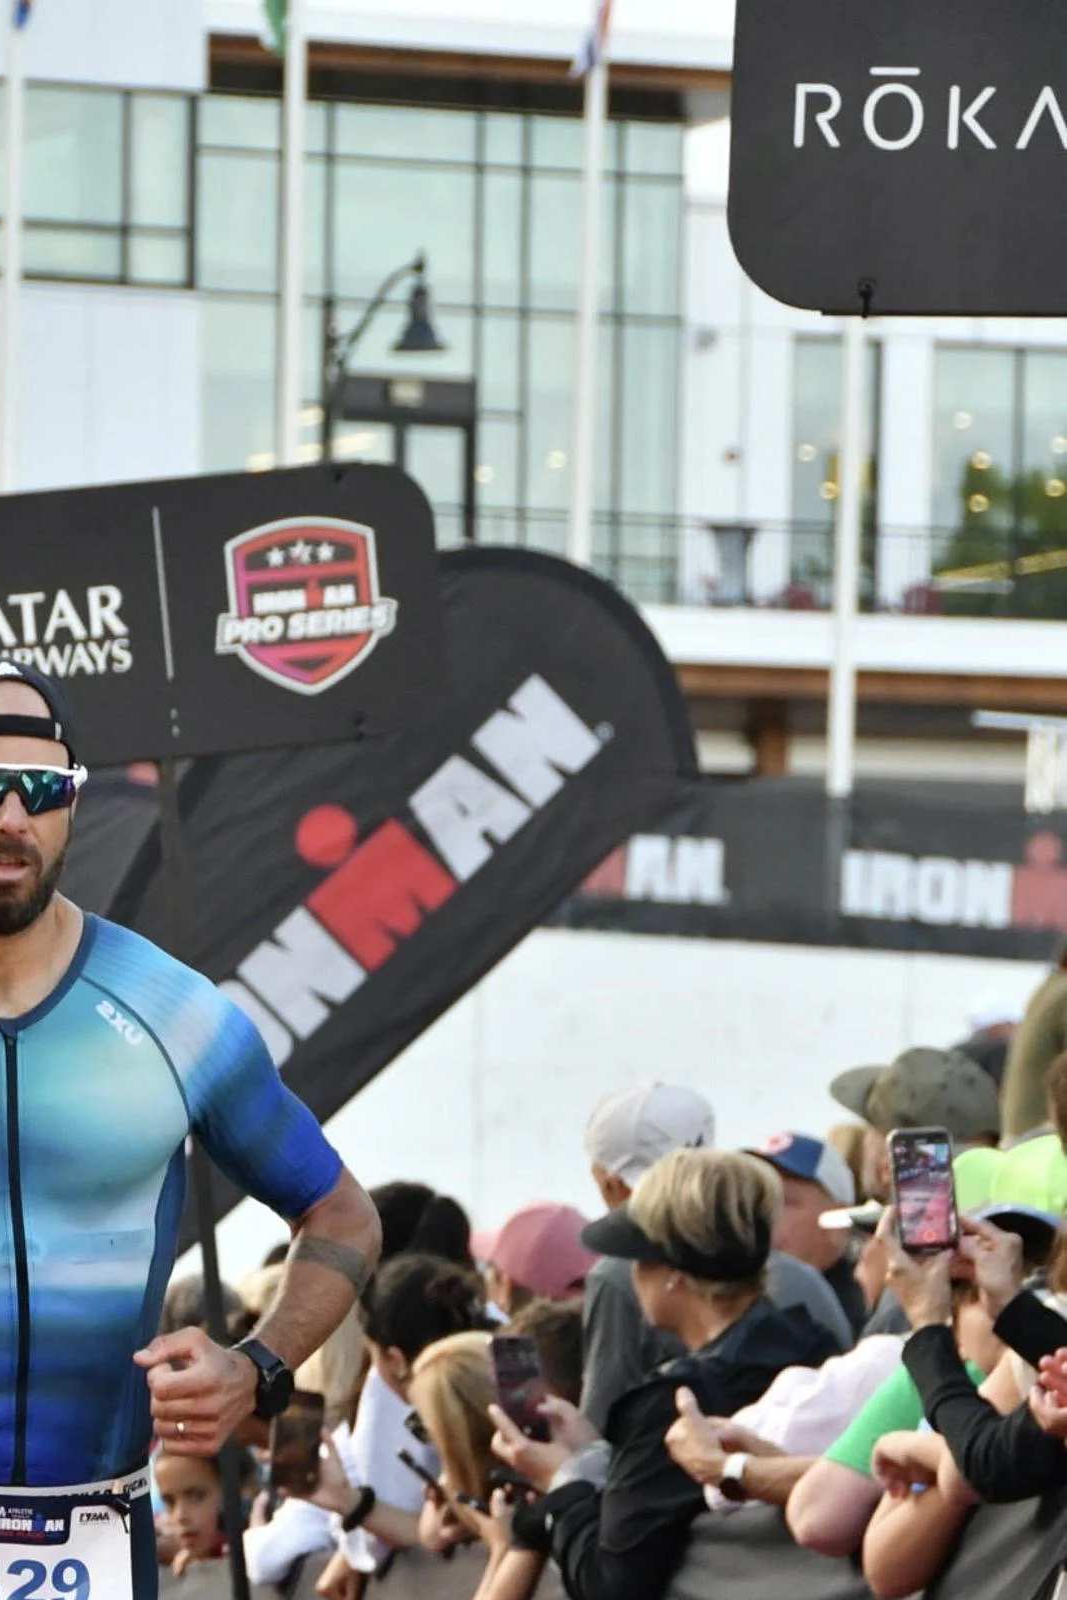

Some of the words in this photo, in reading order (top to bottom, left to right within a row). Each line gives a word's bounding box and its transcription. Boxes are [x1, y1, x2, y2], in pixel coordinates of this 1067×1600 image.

[223, 614, 285, 645] PRO
[286, 603, 390, 641] SERIES
[95, 1000, 144, 1046] 2XU
